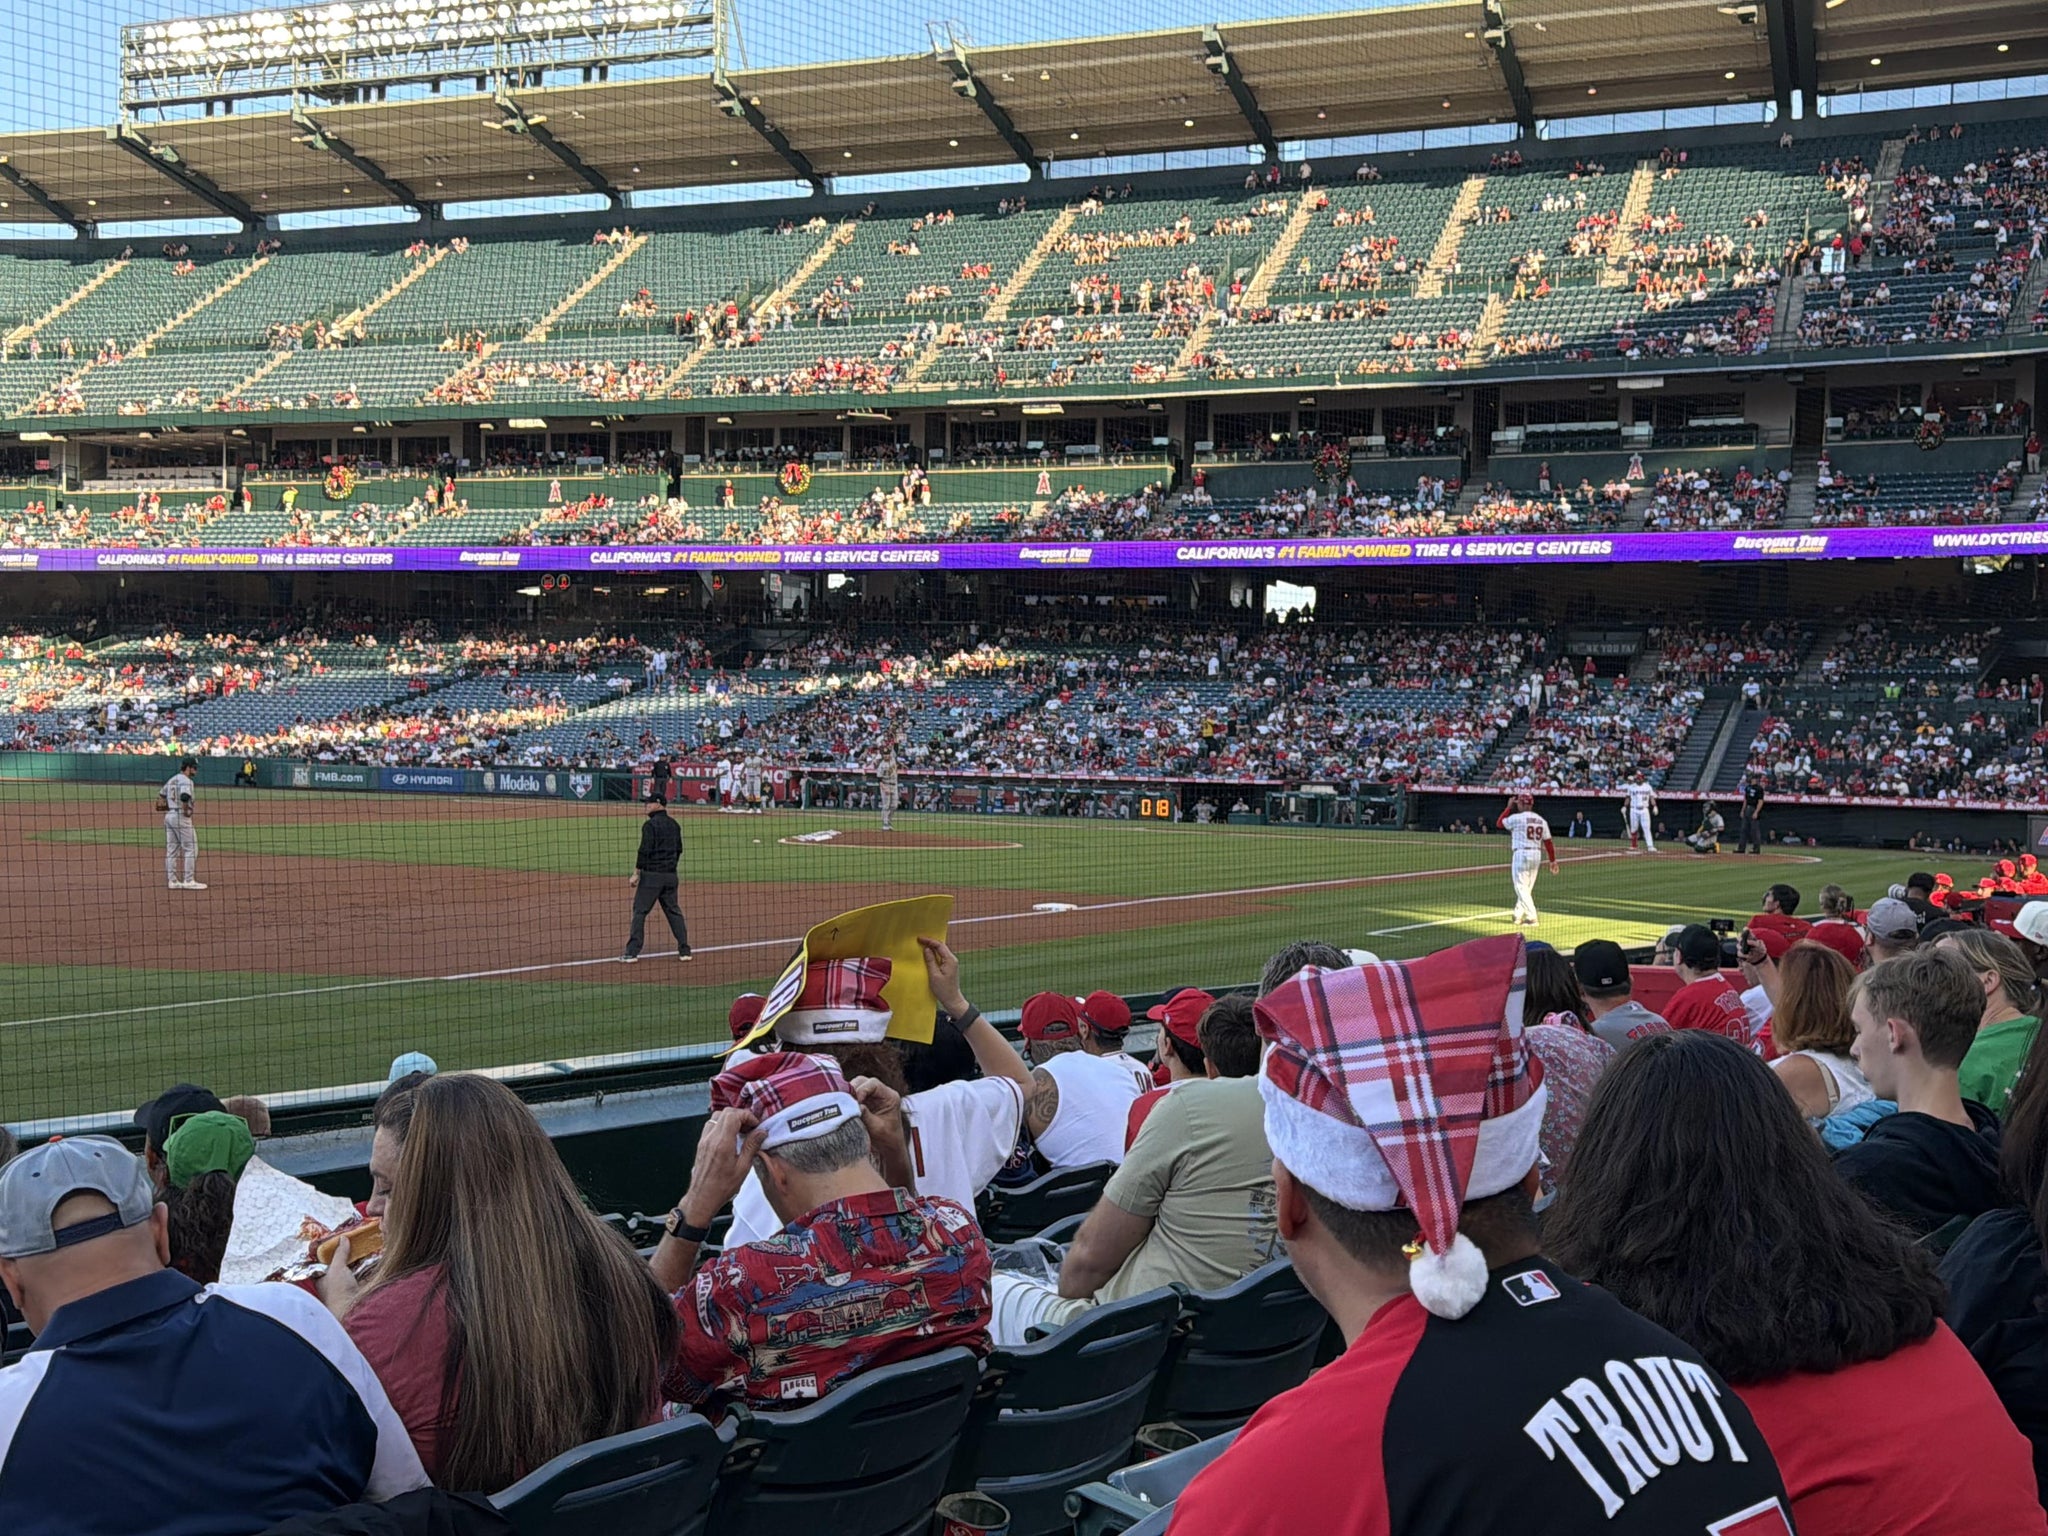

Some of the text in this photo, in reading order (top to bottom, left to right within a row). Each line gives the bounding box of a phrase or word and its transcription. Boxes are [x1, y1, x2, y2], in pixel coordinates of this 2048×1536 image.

[590, 549, 940, 563] CALIFORNIA'S #1 FAMILY-OWNED TIRE & SERVICE CENTERS
[1176, 540, 1612, 559] CALIFORNIA'S #1 FAMILY-OWNED TIRE & SERVICE CENTERS
[97, 554, 393, 565] CALIFORNIA'S #1 FAMILY-OWNED TIRE & SERVICE CENTERS
[315, 771, 364, 783] FMB.com
[500, 773, 540, 792] Modelo
[782, 1378, 816, 1394] ANGELS
[1522, 1356, 1749, 1520] TROUT
